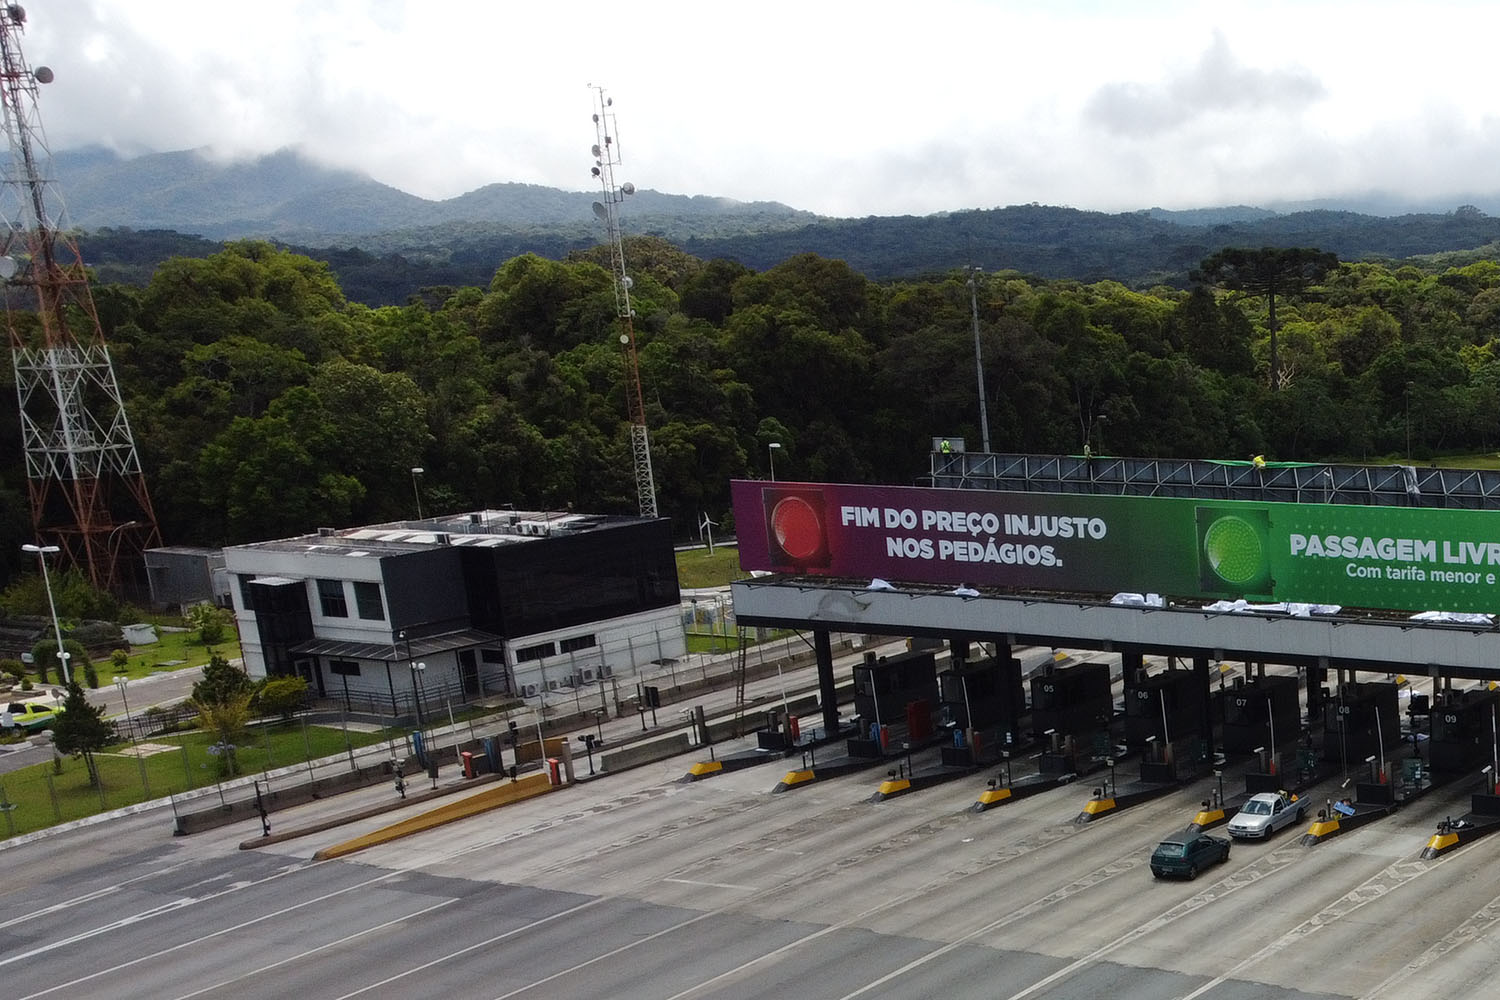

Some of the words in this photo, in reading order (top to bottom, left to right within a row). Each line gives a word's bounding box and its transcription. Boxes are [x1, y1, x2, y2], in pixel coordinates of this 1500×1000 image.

[841, 506, 880, 527] FIM
[884, 508, 917, 529] DO
[922, 510, 999, 537] PREÇO
[1004, 514, 1106, 539] INJUSTO
[887, 537, 934, 559] NOS
[939, 537, 1062, 566] PEDÁGIOS.
[1290, 534, 1436, 562] PASSAGEM
[1346, 563, 1381, 578] Com
[1386, 565, 1425, 581] tarifa
[1431, 570, 1481, 584] menor
[1486, 573, 1495, 584] e
[1043, 684, 1054, 693] 05
[1137, 690, 1149, 700] 06
[1236, 698, 1247, 707] 07
[1338, 705, 1350, 714] 08
[1444, 714, 1457, 723] 09
